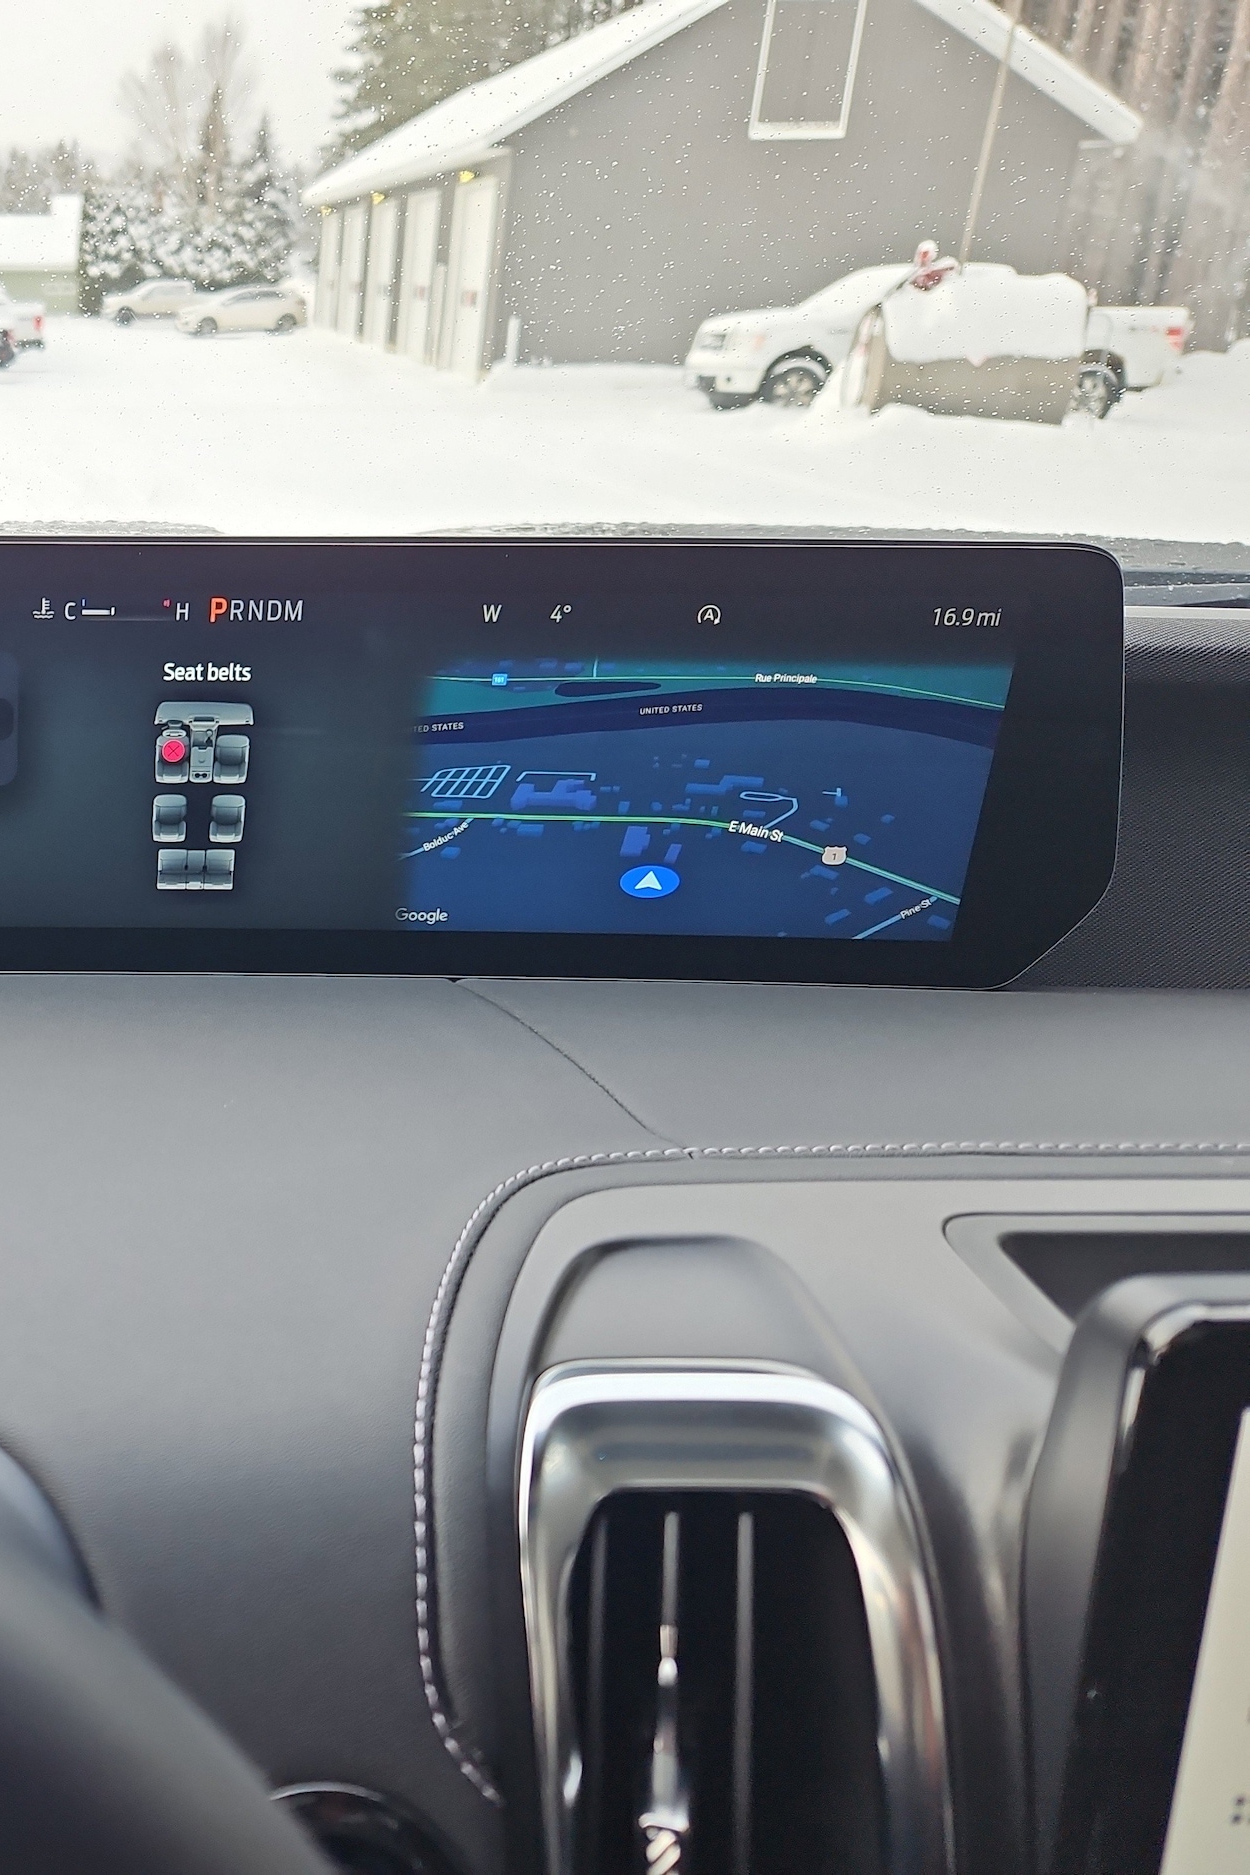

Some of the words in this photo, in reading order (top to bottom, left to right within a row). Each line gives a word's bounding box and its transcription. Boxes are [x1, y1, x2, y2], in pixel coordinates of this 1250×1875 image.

[64, 602, 76, 620] C
[175, 602, 190, 621] H
[209, 597, 303, 622] PRNDM
[483, 604, 502, 623] W
[550, 604, 572, 623] 4°
[933, 607, 975, 626] 16.9
[976, 607, 1002, 626] mi
[163, 662, 203, 682] Seat
[206, 662, 252, 682] belts
[755, 673, 772, 682] Rue
[773, 673, 818, 684] Principale
[639, 705, 670, 716] UNITED
[671, 703, 703, 714] STATES
[431, 721, 464, 732] STATES
[423, 832, 454, 852] Bolduc
[453, 822, 469, 836] Ave
[728, 820, 739, 832] E
[739, 822, 769, 838] Main
[770, 829, 784, 842] St
[395, 907, 449, 925] Google
[900, 904, 921, 919] Pine
[919, 898, 931, 909] St
